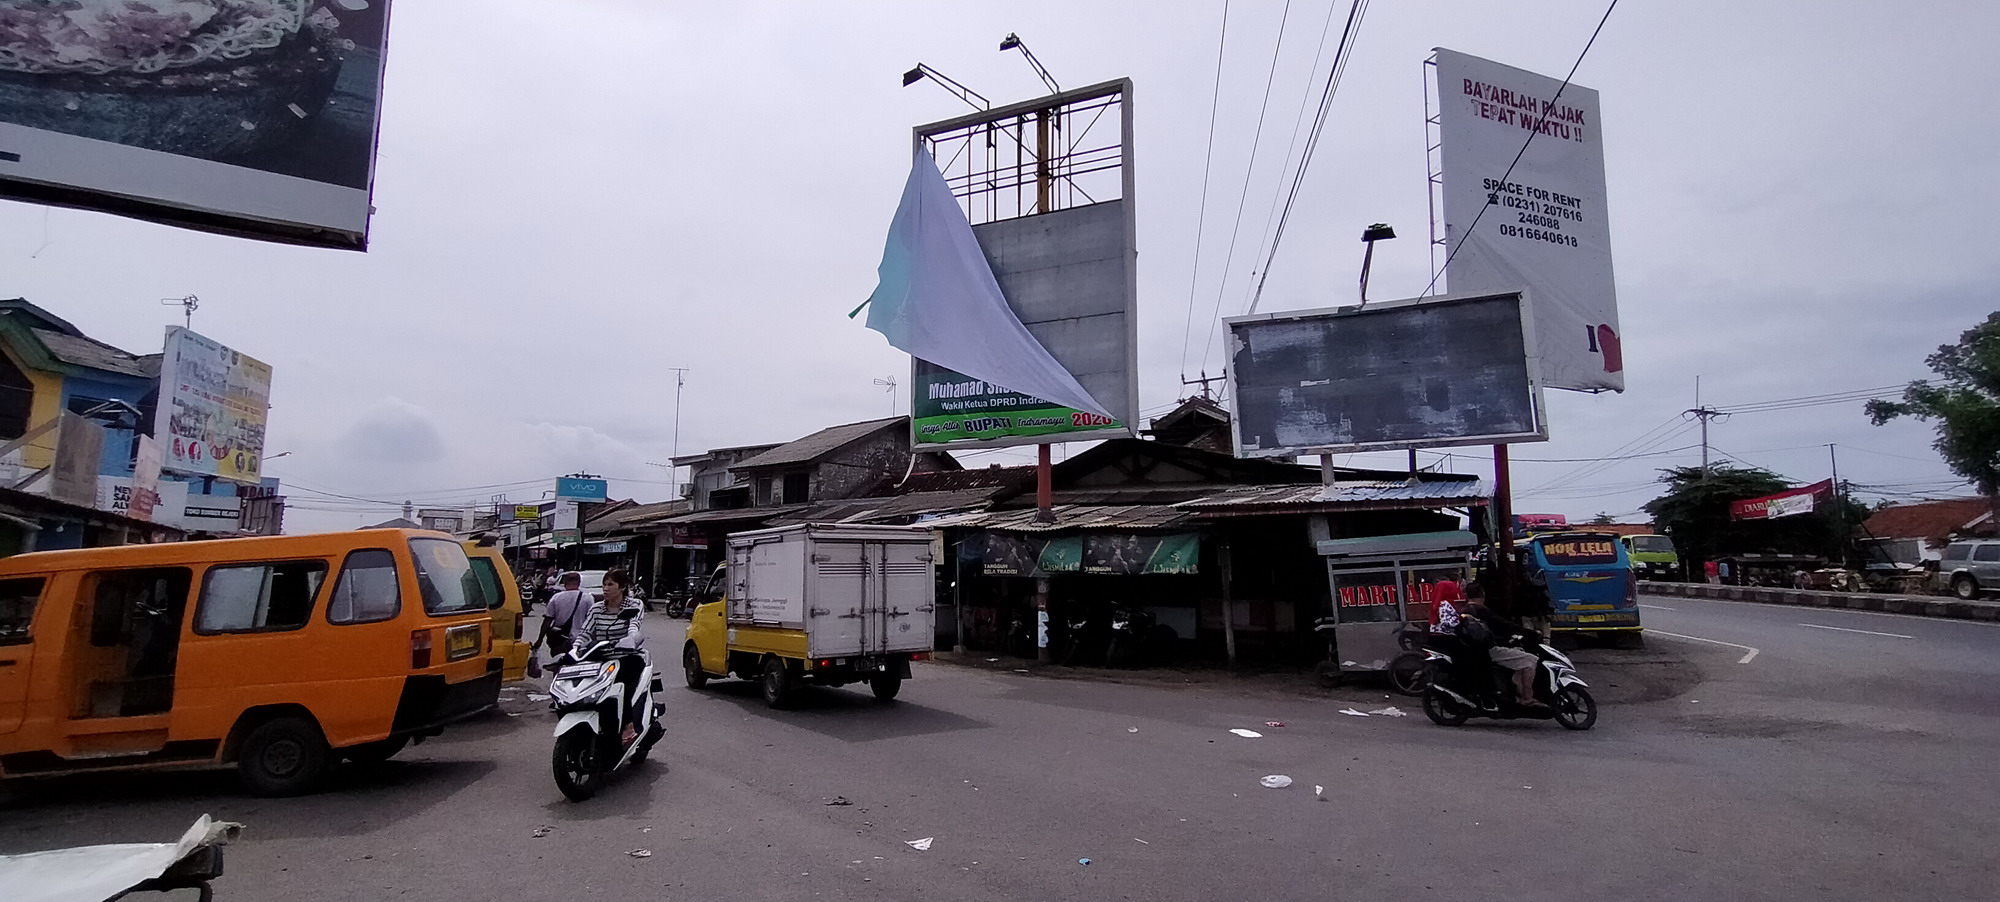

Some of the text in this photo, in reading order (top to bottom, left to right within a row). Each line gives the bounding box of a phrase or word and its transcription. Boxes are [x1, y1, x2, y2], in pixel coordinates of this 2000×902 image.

[1463, 78, 1586, 126] BAYARLAH PAJAK
[1471, 99, 1583, 143] TEPAT WAKTU !!
[1483, 178, 1582, 209] SPACE FOR RENT
[1502, 195, 1583, 223] (0231) 207616
[1518, 212, 1560, 230] 246088
[1500, 223, 1578, 248] 0816640618
[928, 380, 984, 400] Muhamad
[941, 401, 964, 411] Wakil
[964, 399, 988, 409] Ketua
[990, 396, 1017, 408] DPRD
[963, 416, 1013, 433] BUPATI
[1017, 416, 1065, 428] Indramayu
[1544, 542, 1576, 555] NOK
[1580, 541, 1613, 553] LELA
